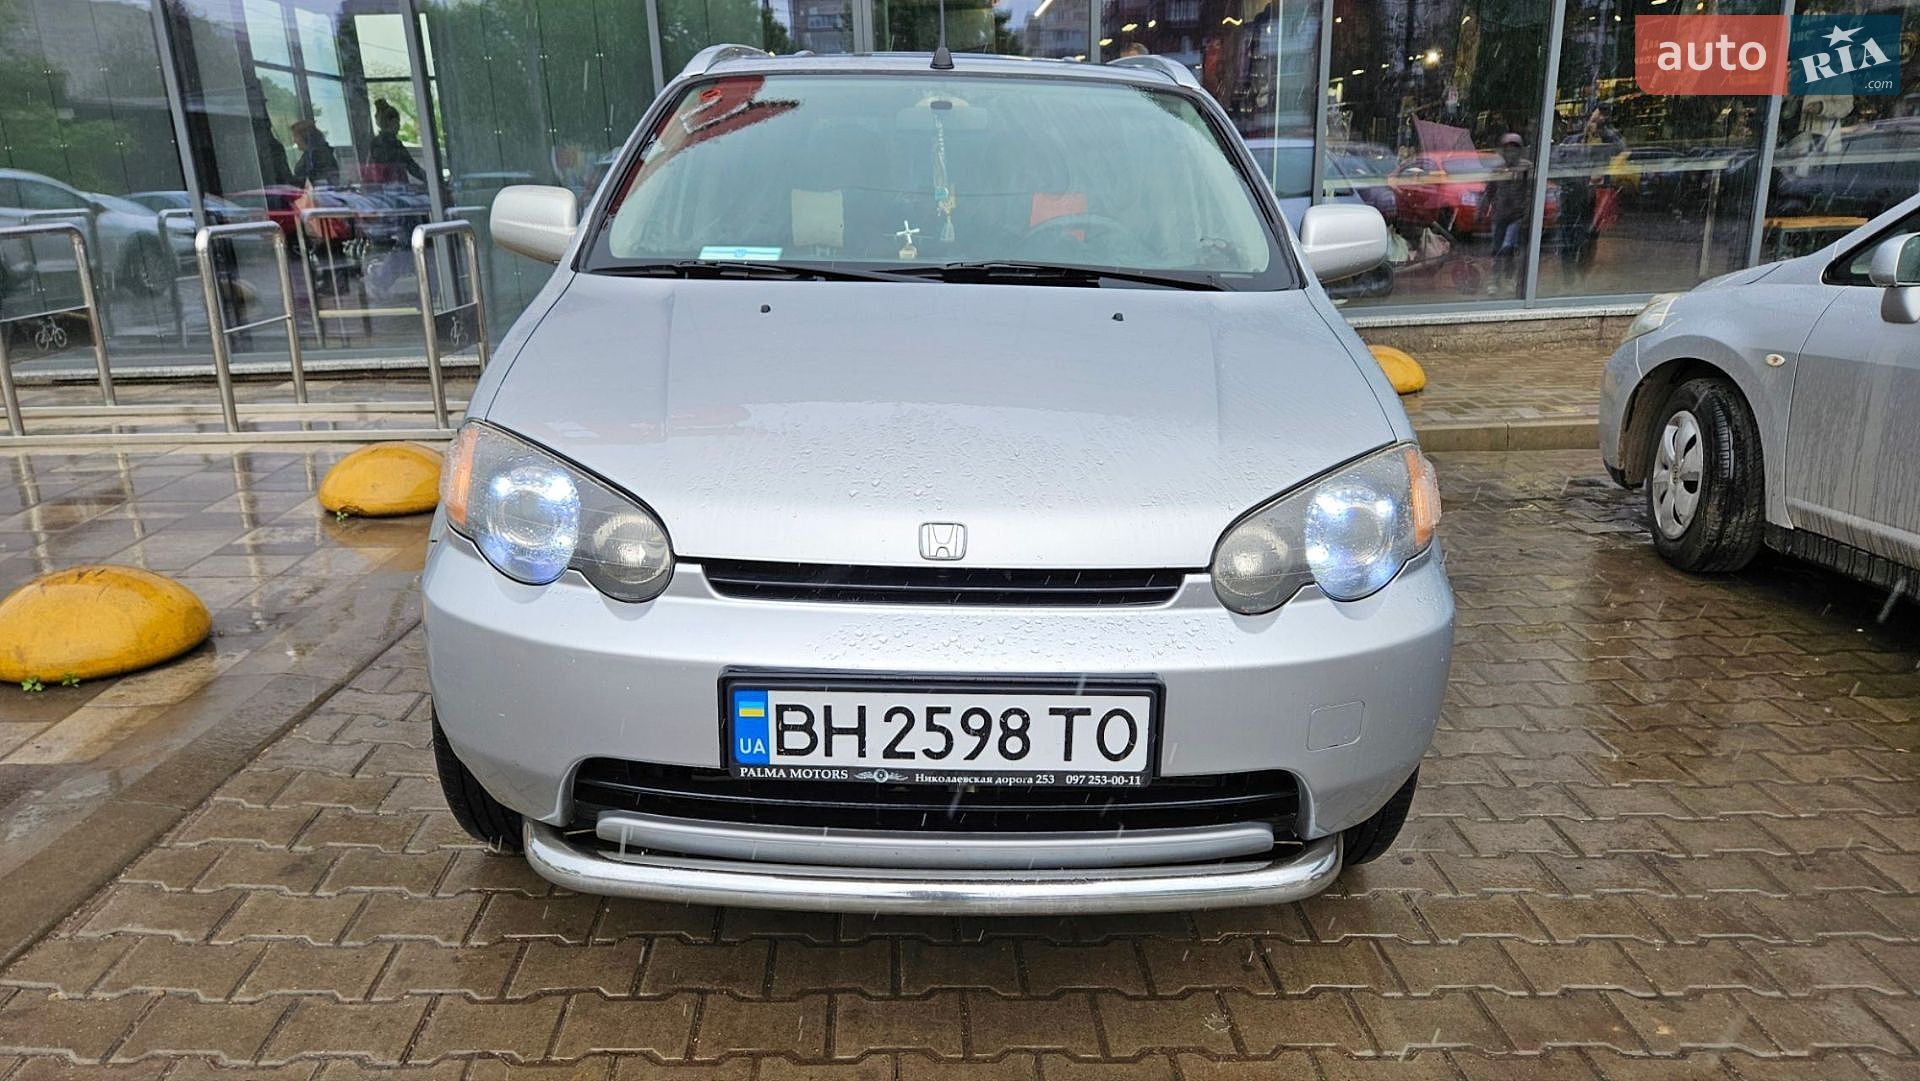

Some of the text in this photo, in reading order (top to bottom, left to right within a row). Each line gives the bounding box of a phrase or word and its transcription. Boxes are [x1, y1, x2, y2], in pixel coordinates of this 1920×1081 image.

[775, 703, 1138, 763] BH 2598 TO
[739, 738, 766, 755] UA
[739, 767, 849, 780] PALMA MOTORS
[915, 773, 1055, 786] Николаевская дорога 253
[1065, 774, 1141, 786] 097 253-00-11
